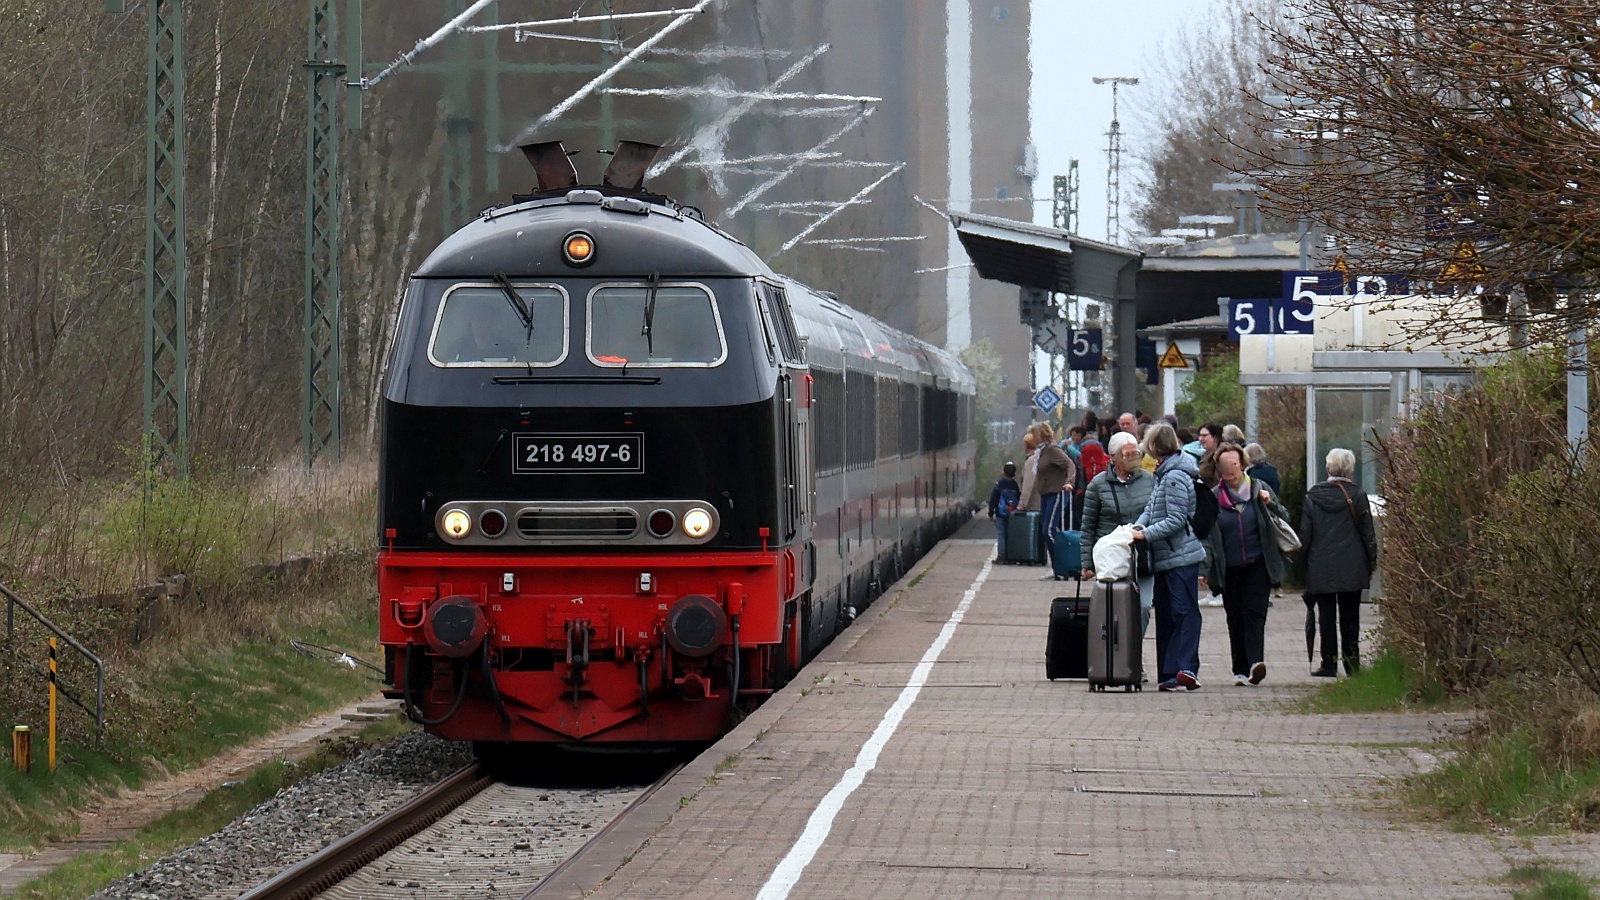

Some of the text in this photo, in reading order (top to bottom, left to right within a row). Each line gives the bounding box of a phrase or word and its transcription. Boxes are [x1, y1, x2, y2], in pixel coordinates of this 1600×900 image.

[1291, 276, 1318, 322] 5
[1234, 302, 1256, 335] 5
[1072, 330, 1089, 357] 5
[526, 444, 631, 462] 218 497-6
